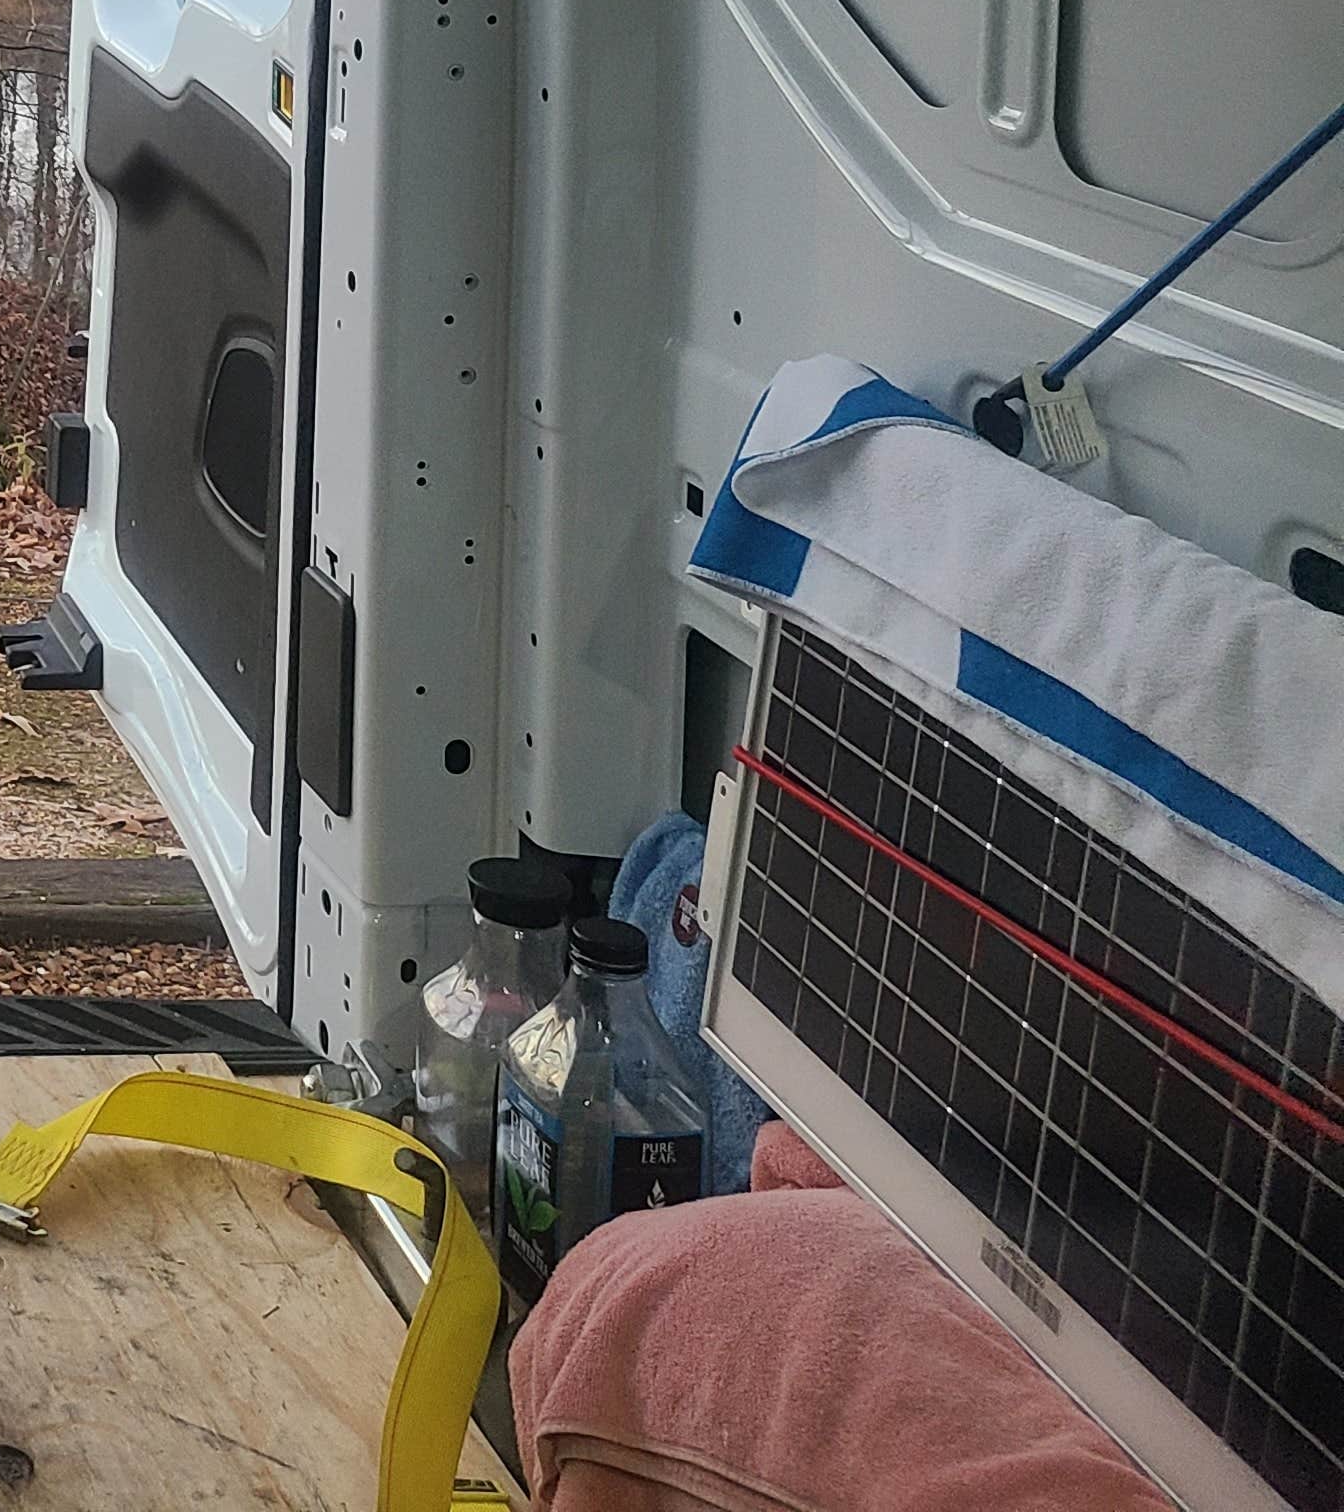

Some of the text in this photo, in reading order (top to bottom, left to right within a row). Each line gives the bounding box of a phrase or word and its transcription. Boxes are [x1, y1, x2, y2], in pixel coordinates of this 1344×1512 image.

[510, 1108, 552, 1170] PURE
[642, 1141, 675, 1153] PURE
[510, 1128, 551, 1195] LEAF
[641, 1152, 676, 1164] LEAF
